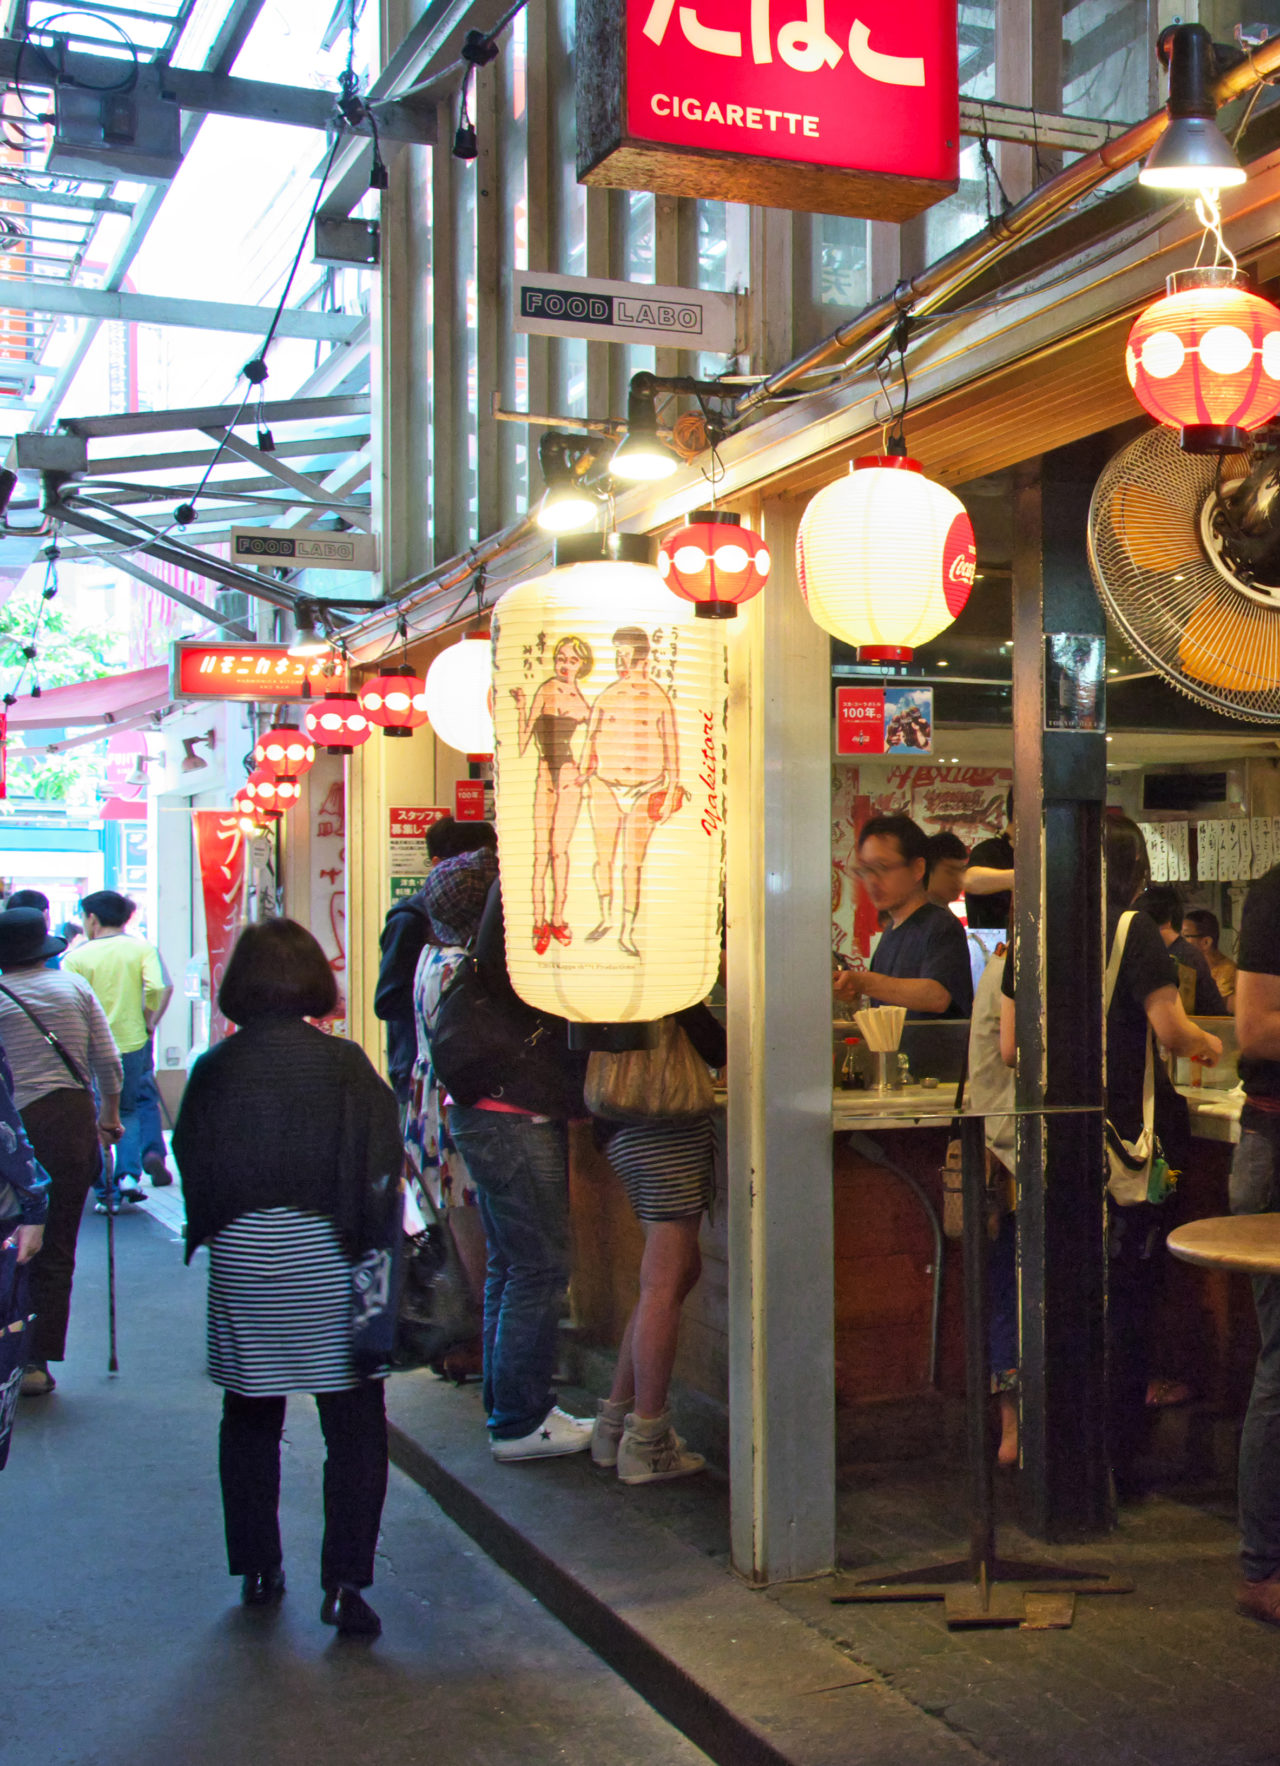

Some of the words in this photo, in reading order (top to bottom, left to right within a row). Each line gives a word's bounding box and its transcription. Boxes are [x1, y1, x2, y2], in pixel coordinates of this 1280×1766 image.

[650, 93, 820, 138] CIGARETTE
[525, 292, 609, 321] FOOD
[617, 301, 698, 329] LABO
[238, 537, 294, 555] FOOD
[297, 540, 354, 559] LABO
[842, 707, 882, 719] 100年。
[699, 709, 723, 837] Yakitori
